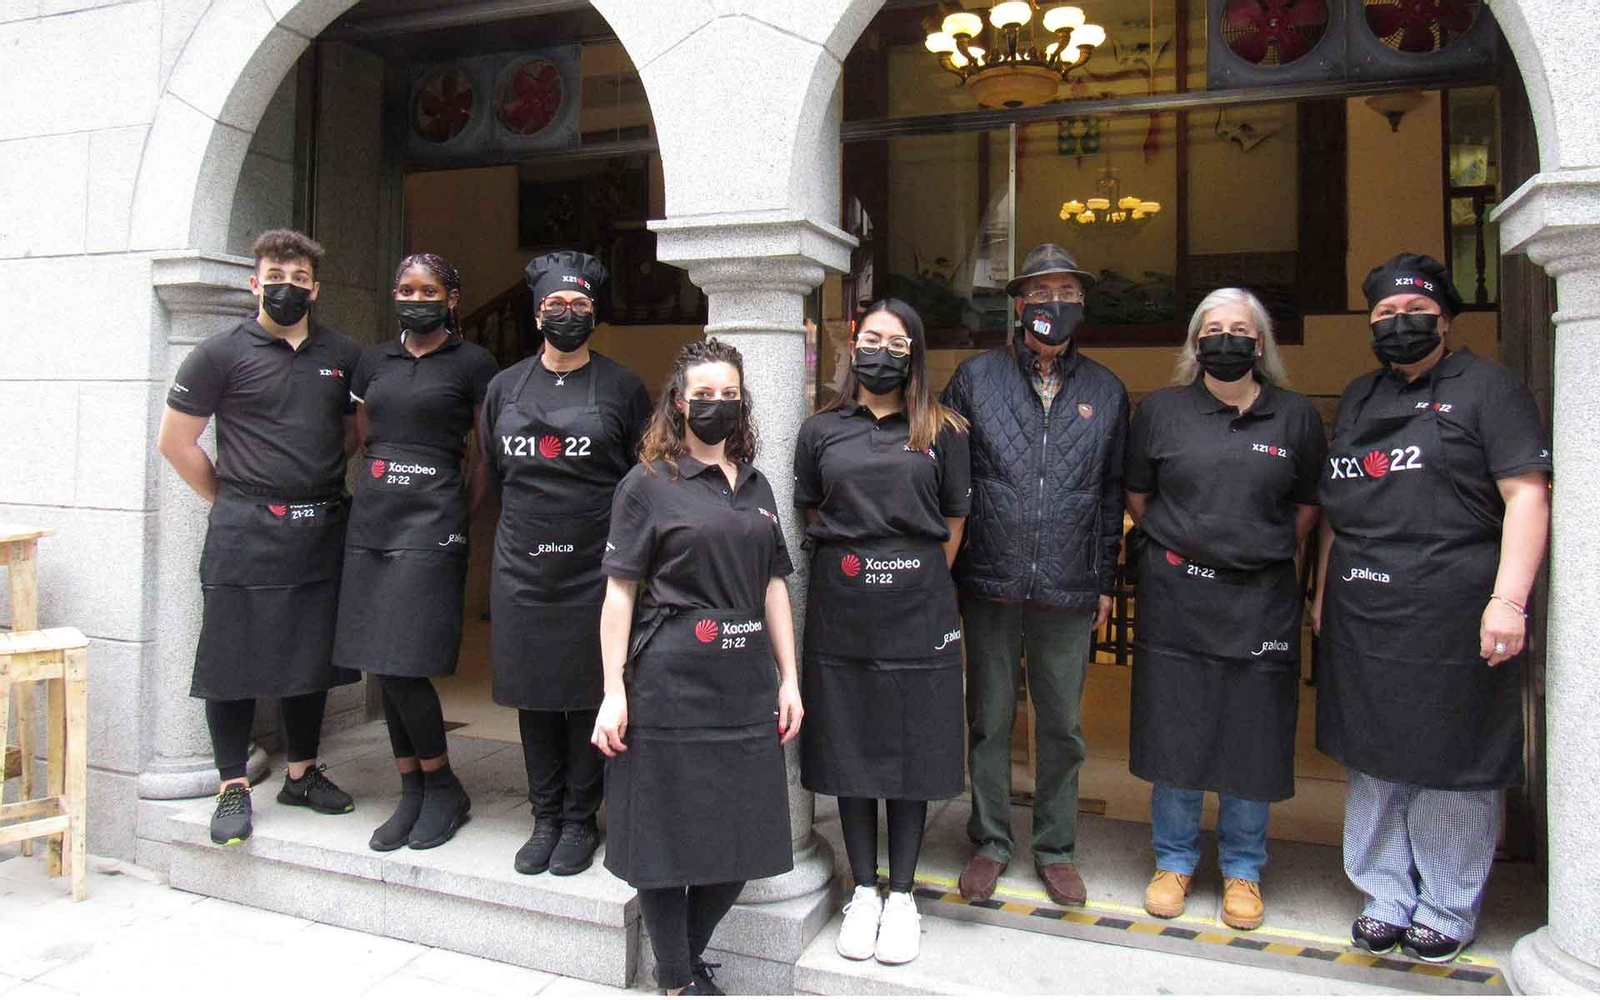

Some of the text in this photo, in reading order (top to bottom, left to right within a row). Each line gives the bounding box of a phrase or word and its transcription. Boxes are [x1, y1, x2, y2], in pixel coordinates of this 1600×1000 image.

[562, 275, 577, 283] X21
[1395, 277, 1434, 291] X21 22
[501, 435, 592, 456] X21 22
[1251, 443, 1287, 458] X21 22
[388, 461, 437, 476] Xacobeo
[1329, 445, 1424, 480] X21 22
[528, 541, 574, 557] galicia
[865, 557, 921, 570] Xacobeo
[1341, 566, 1390, 583] galicia
[722, 619, 763, 635] Xacobeo
